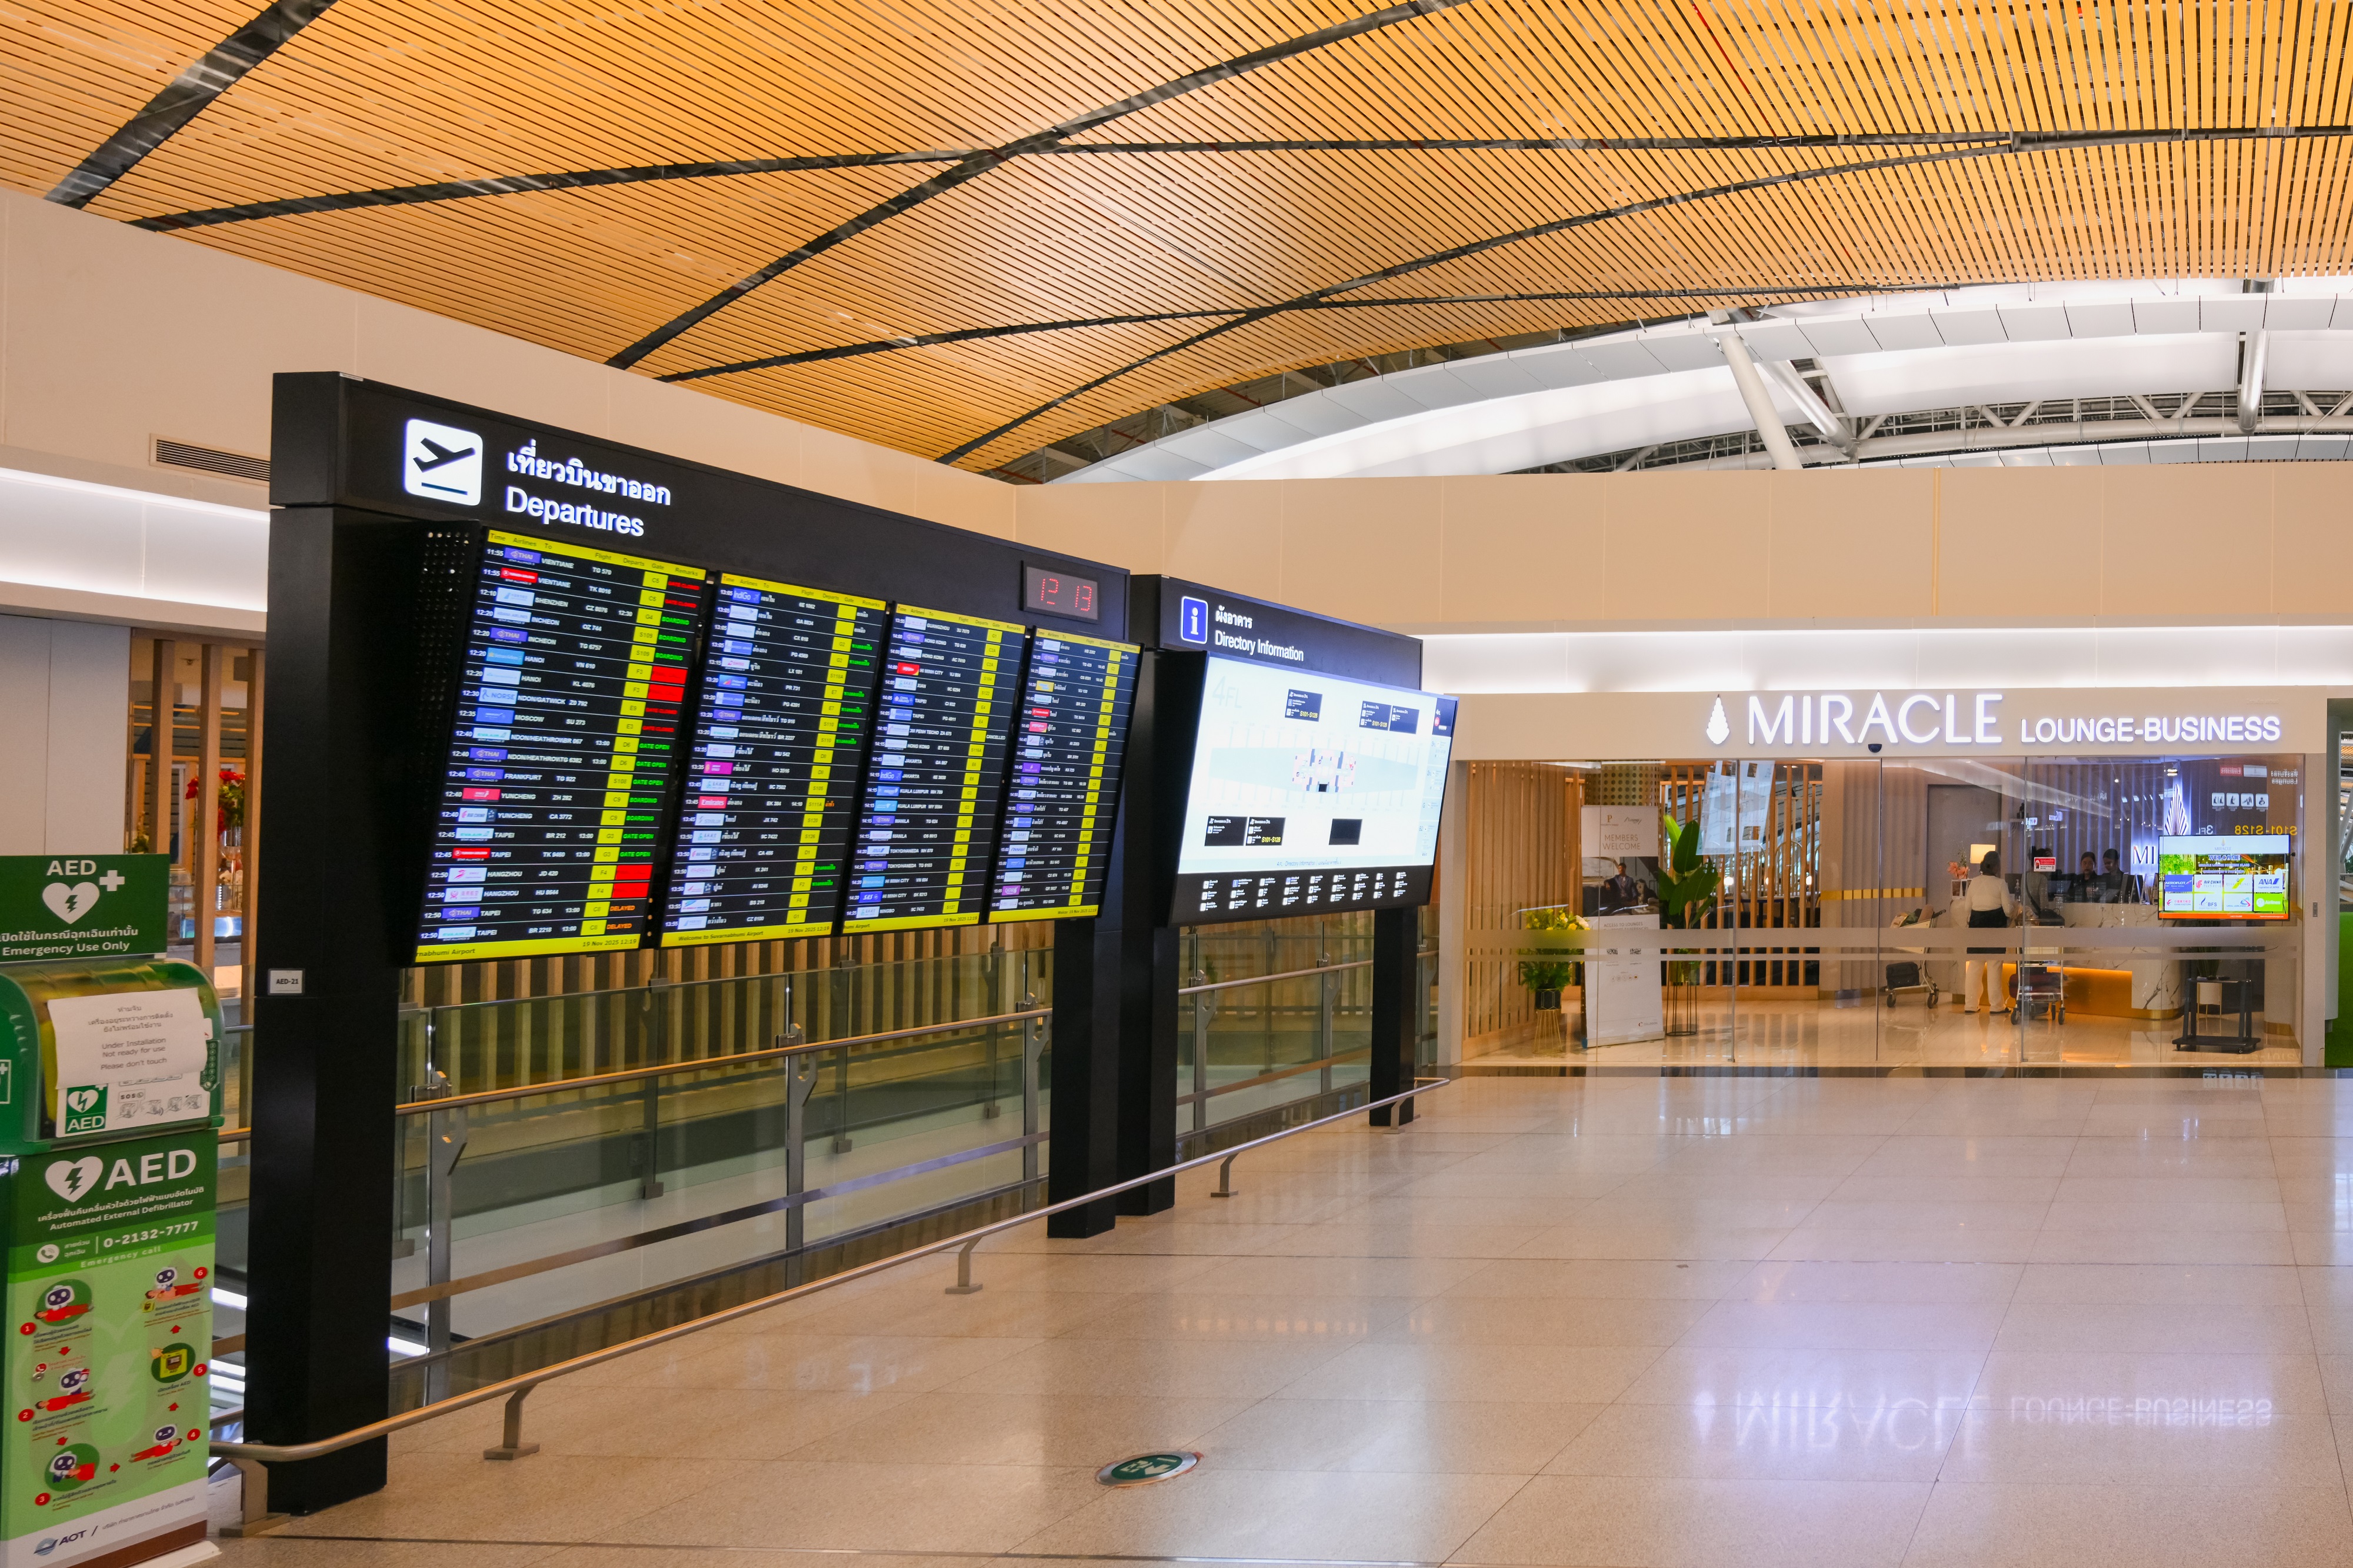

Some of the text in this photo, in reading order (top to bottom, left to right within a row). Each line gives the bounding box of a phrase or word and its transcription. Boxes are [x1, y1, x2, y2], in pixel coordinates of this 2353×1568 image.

[508, 439, 671, 505] เที่ยวบินขาออก
[506, 486, 644, 536] Departures
[512, 538, 537, 548] Airlines
[595, 552, 611, 561] Flight
[623, 558, 645, 567] Departs
[675, 568, 698, 576] Remarks
[541, 558, 574, 568] VIENTIANE
[538, 578, 571, 588] VIENTIANE
[733, 589, 751, 600] IndiGo
[1041, 578, 1092, 611] 12 13
[534, 597, 568, 607] SHENZHEN
[661, 616, 689, 625] BOARDING
[1216, 605, 1252, 629] ผังอาคาร
[531, 617, 559, 626] INCHEON
[658, 635, 686, 643] BOARDING
[528, 636, 556, 645] INCHEON
[1215, 630, 1304, 661] Directory Information
[1749, 691, 2281, 744] MIRACLE LOUNGE-BUSINESS
[2133, 845, 2156, 865] MI
[46, 860, 97, 876] AED
[486, 870, 522, 879] HANGZHOU
[609, 904, 635, 913] DELAYED
[606, 922, 632, 930] DELAYED
[746, 930, 764, 938] Airport
[2, 941, 131, 956] Emergency Use Only
[451, 947, 475, 956] Airport
[102, 1037, 166, 1050] Under Installation
[102, 1050, 115, 1058] Not
[118, 1048, 138, 1057] ready
[101, 1057, 167, 1070] Please don't touch
[67, 1115, 105, 1132] AED
[105, 1149, 196, 1190] AED
[49, 1199, 194, 1230] Automated External Defibrillator
[104, 1221, 198, 1248] 0-2132-7777
[81, 1245, 161, 1268] Emergency call
[59, 1530, 87, 1546] AOT
